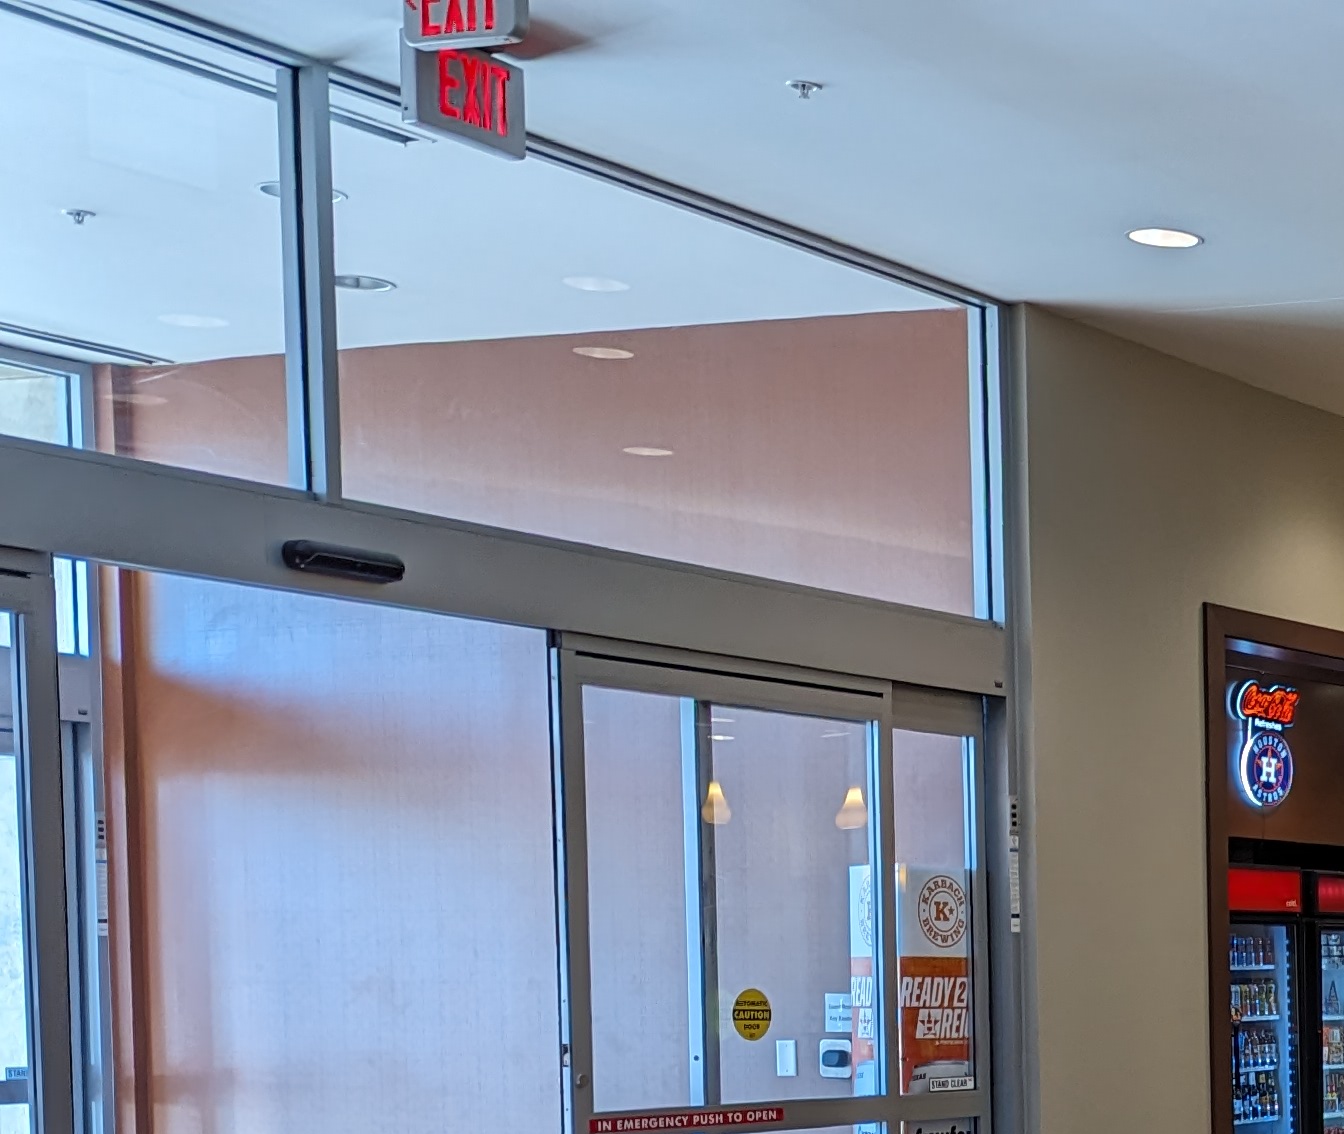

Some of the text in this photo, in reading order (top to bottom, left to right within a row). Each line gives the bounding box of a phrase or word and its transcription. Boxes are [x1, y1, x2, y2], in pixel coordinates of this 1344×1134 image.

[438, 49, 510, 137] EXIT
[1252, 735, 1288, 759] HOUSTON
[1260, 756, 1278, 783] H
[1252, 783, 1284, 803] ASTROS
[921, 879, 965, 907] KARBACH
[933, 901, 949, 922] K
[922, 916, 965, 944] BREWING
[900, 976, 953, 1007] READY
[734, 1010, 770, 1021] CAUTION
[940, 1008, 969, 1039] REI
[931, 1079, 950, 1090] STAND
[597, 1110, 777, 1132] IN EMERGENCY PUSH TO OPEN
